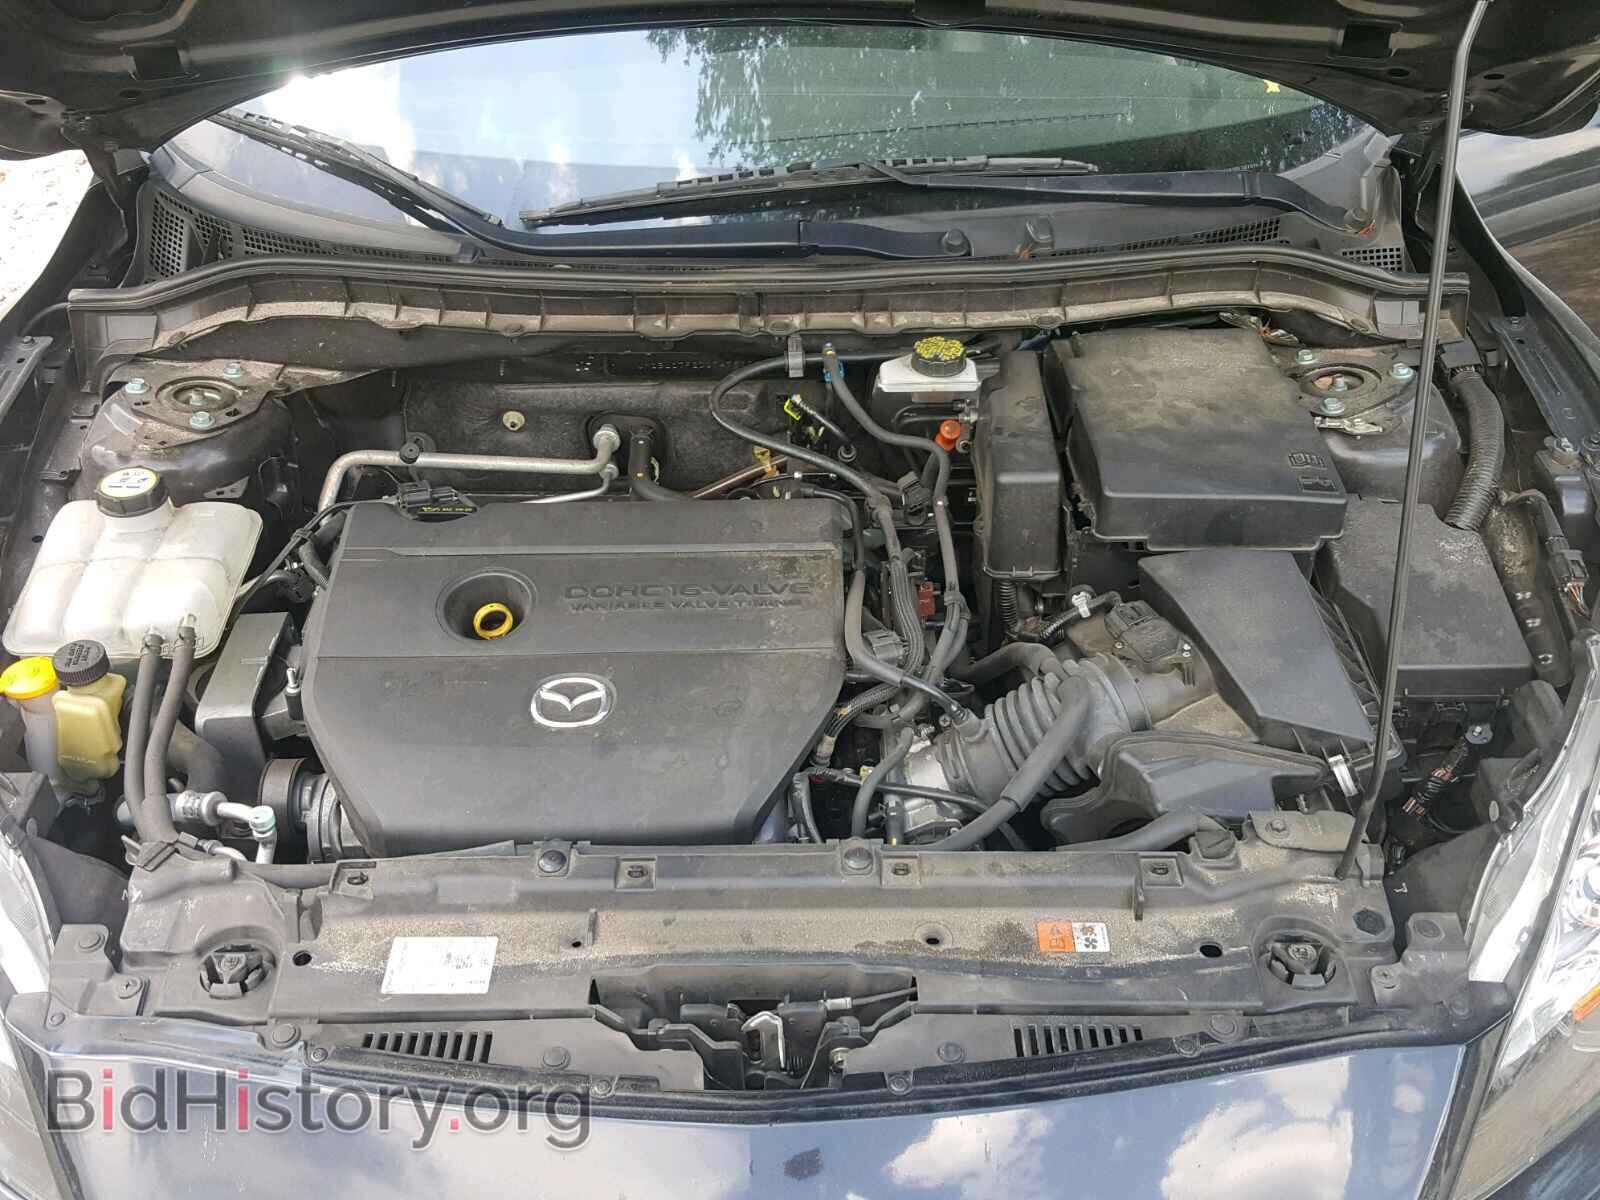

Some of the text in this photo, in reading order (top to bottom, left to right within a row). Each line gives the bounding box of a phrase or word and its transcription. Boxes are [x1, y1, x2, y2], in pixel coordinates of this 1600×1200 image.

[565, 584, 664, 600] DOHC
[568, 599, 802, 611] VARIABLE VALVE TIMING
